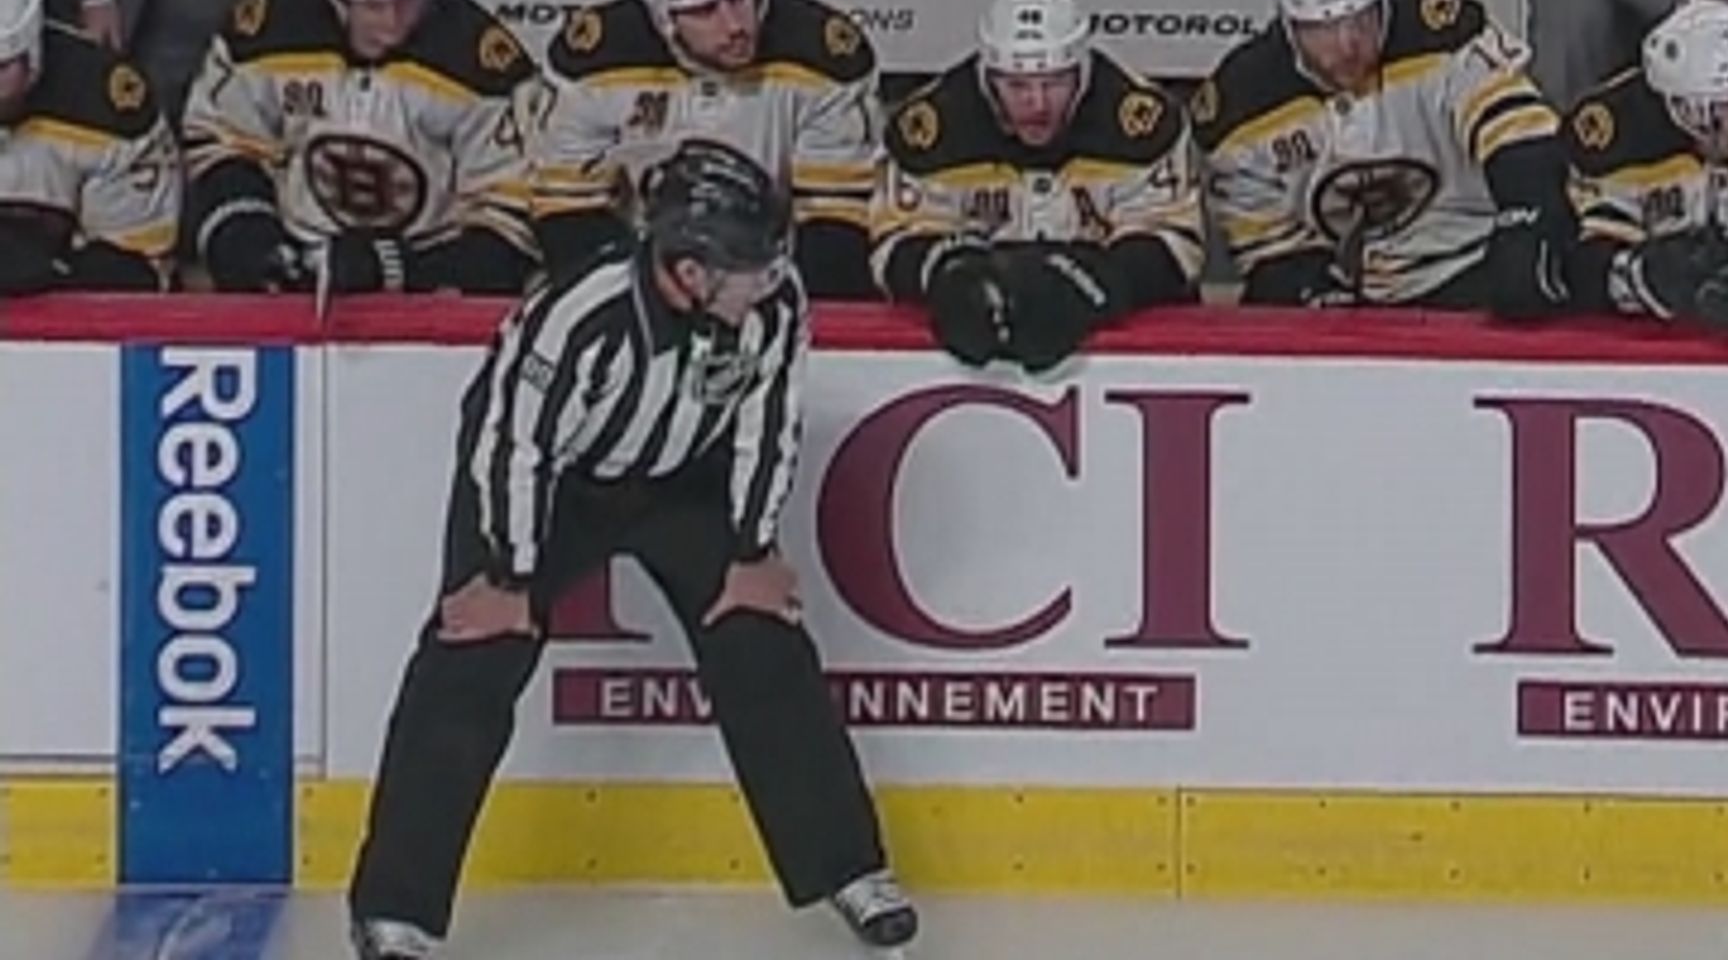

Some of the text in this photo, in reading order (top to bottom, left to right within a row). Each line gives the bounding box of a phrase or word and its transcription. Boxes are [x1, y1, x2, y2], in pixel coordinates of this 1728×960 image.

[1089, 12, 1260, 38] OTOROL
[157, 347, 257, 775] Reebok
[546, 381, 1250, 652] CI
[604, 680, 1158, 724] ENVNNEMENT
